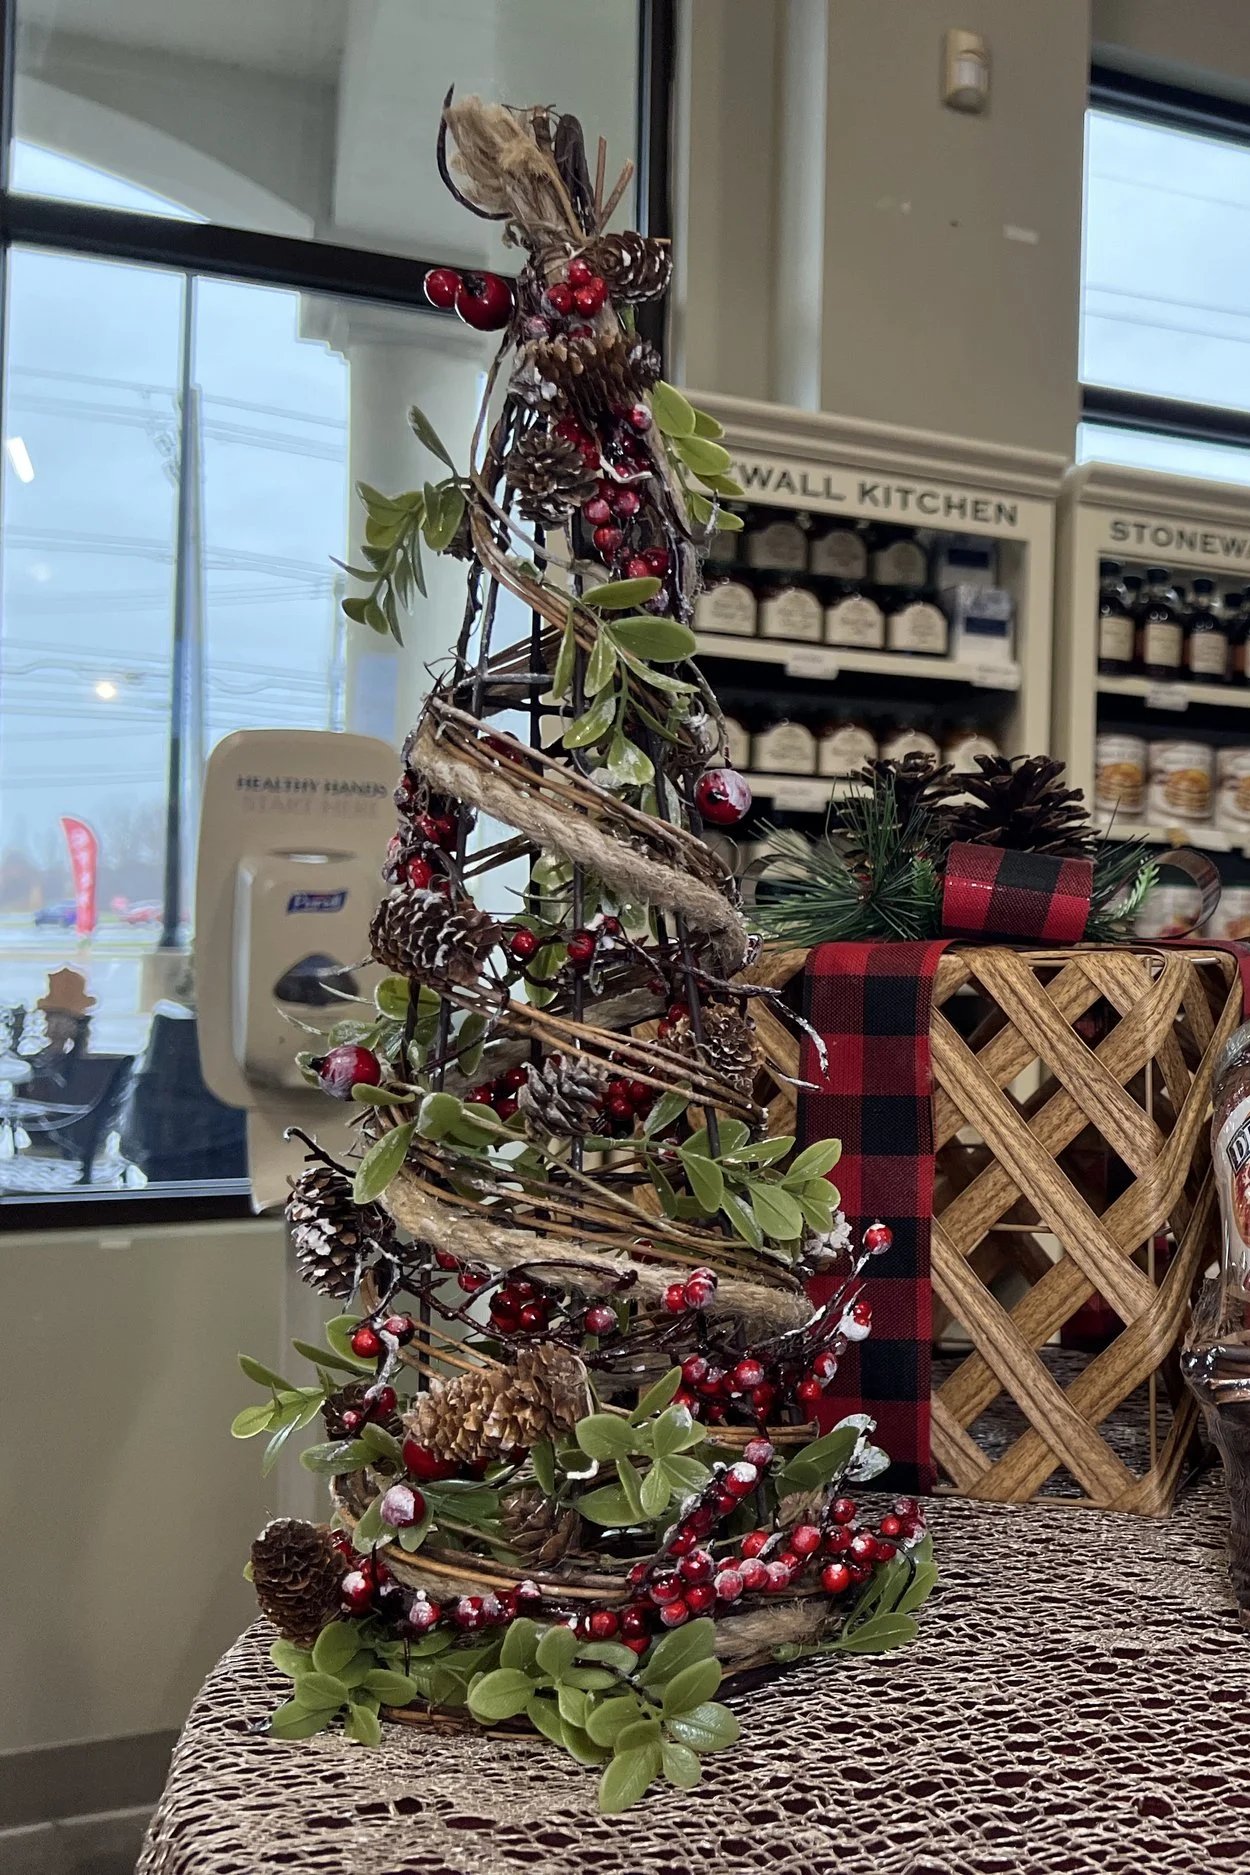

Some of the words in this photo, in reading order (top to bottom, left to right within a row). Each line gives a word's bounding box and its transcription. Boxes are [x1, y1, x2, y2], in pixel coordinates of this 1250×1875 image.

[730, 461, 847, 501] WALL
[857, 480, 1019, 527] KITCHEN
[236, 775, 318, 792] HEALTHY
